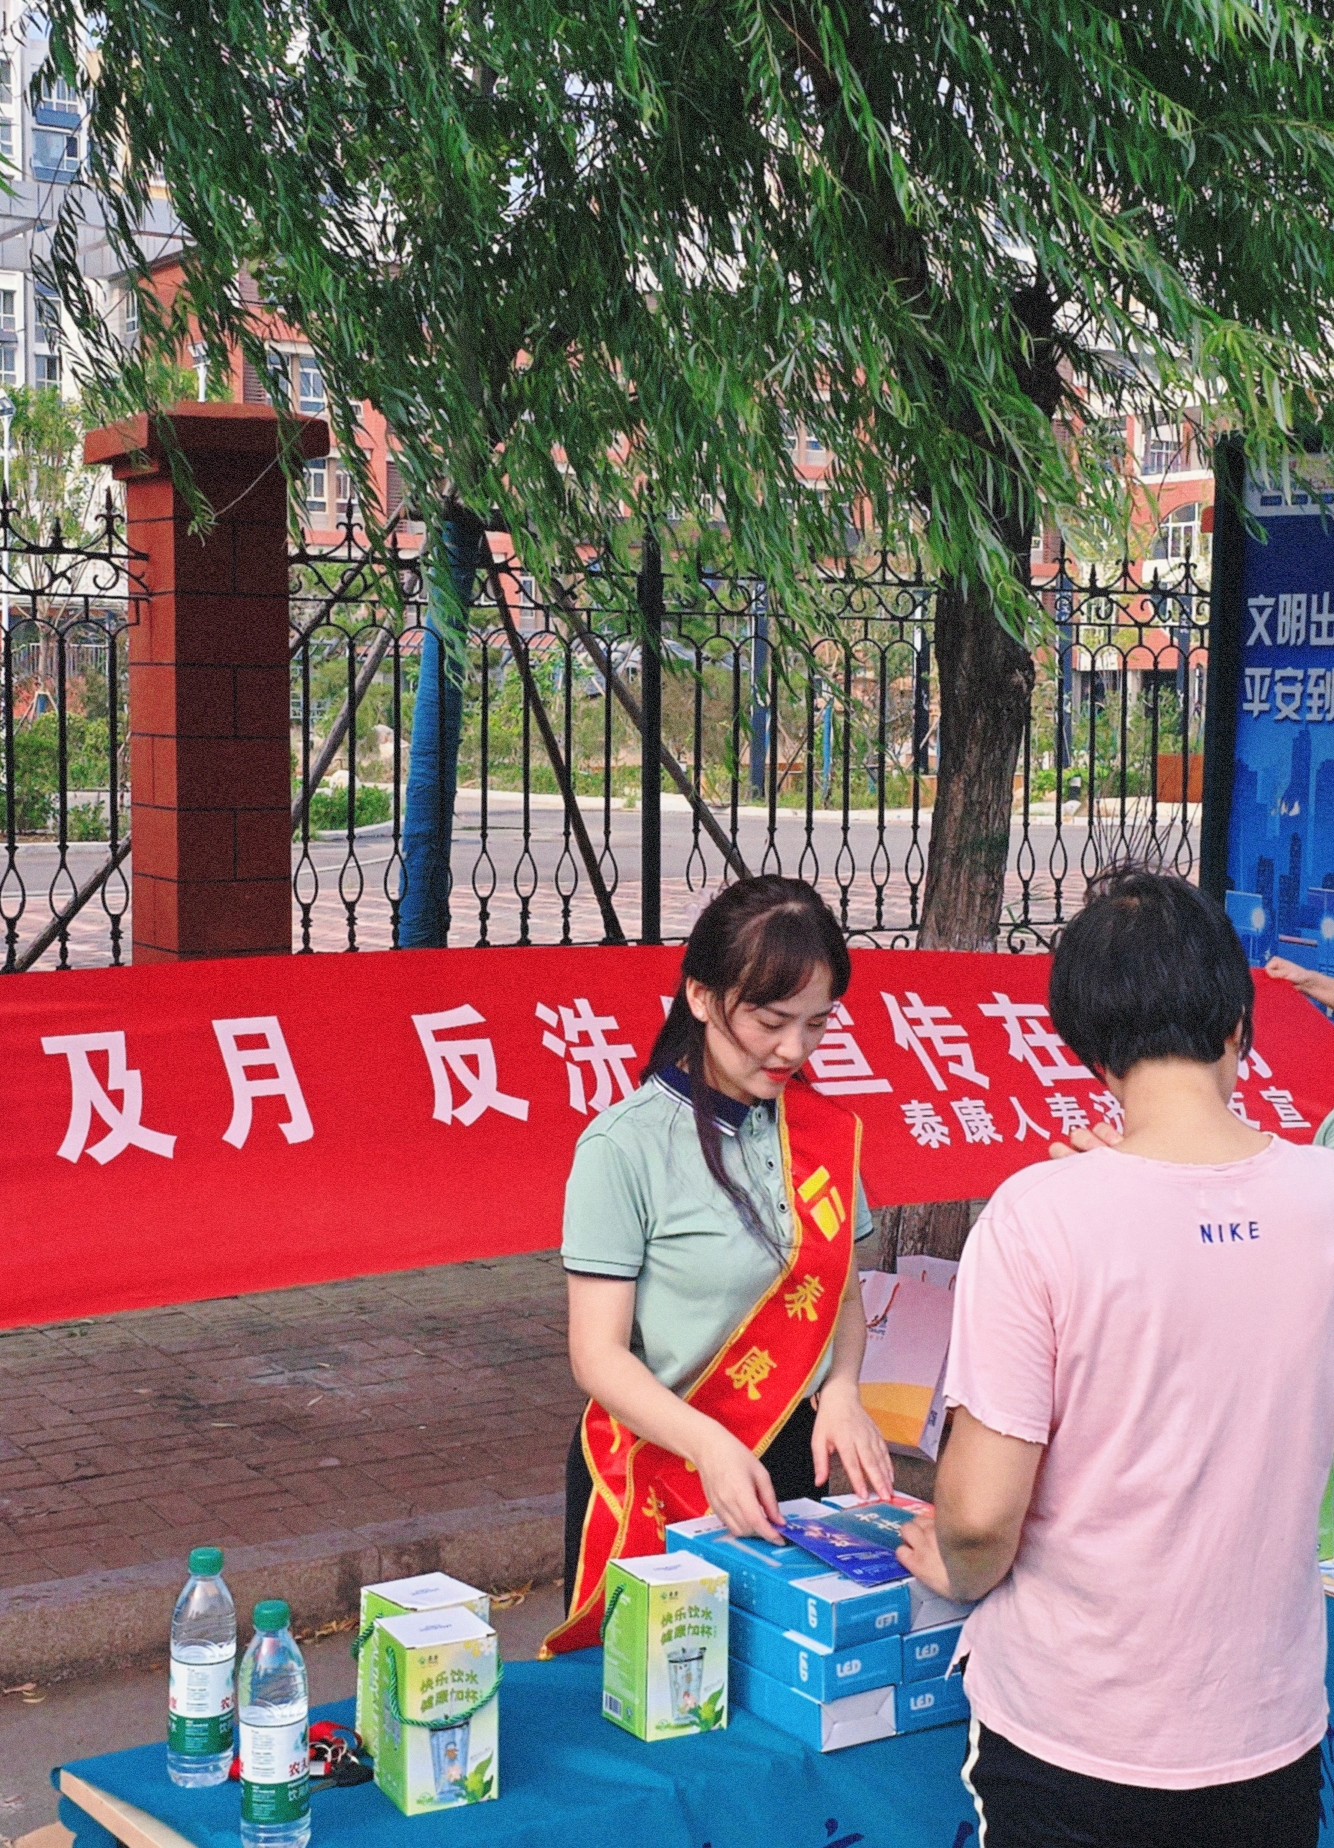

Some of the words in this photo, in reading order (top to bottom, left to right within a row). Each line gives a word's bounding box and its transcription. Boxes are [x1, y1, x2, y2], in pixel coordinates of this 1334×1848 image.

[411, 990, 1273, 1128] 反洗宣传在
[1200, 1220, 1260, 1245] NIKE
[807, 1597, 818, 1629] LED
[915, 1643, 940, 1660] LED
[799, 1651, 809, 1683] LED
[836, 1659, 862, 1678] LED
[910, 1693, 935, 1711] LED
